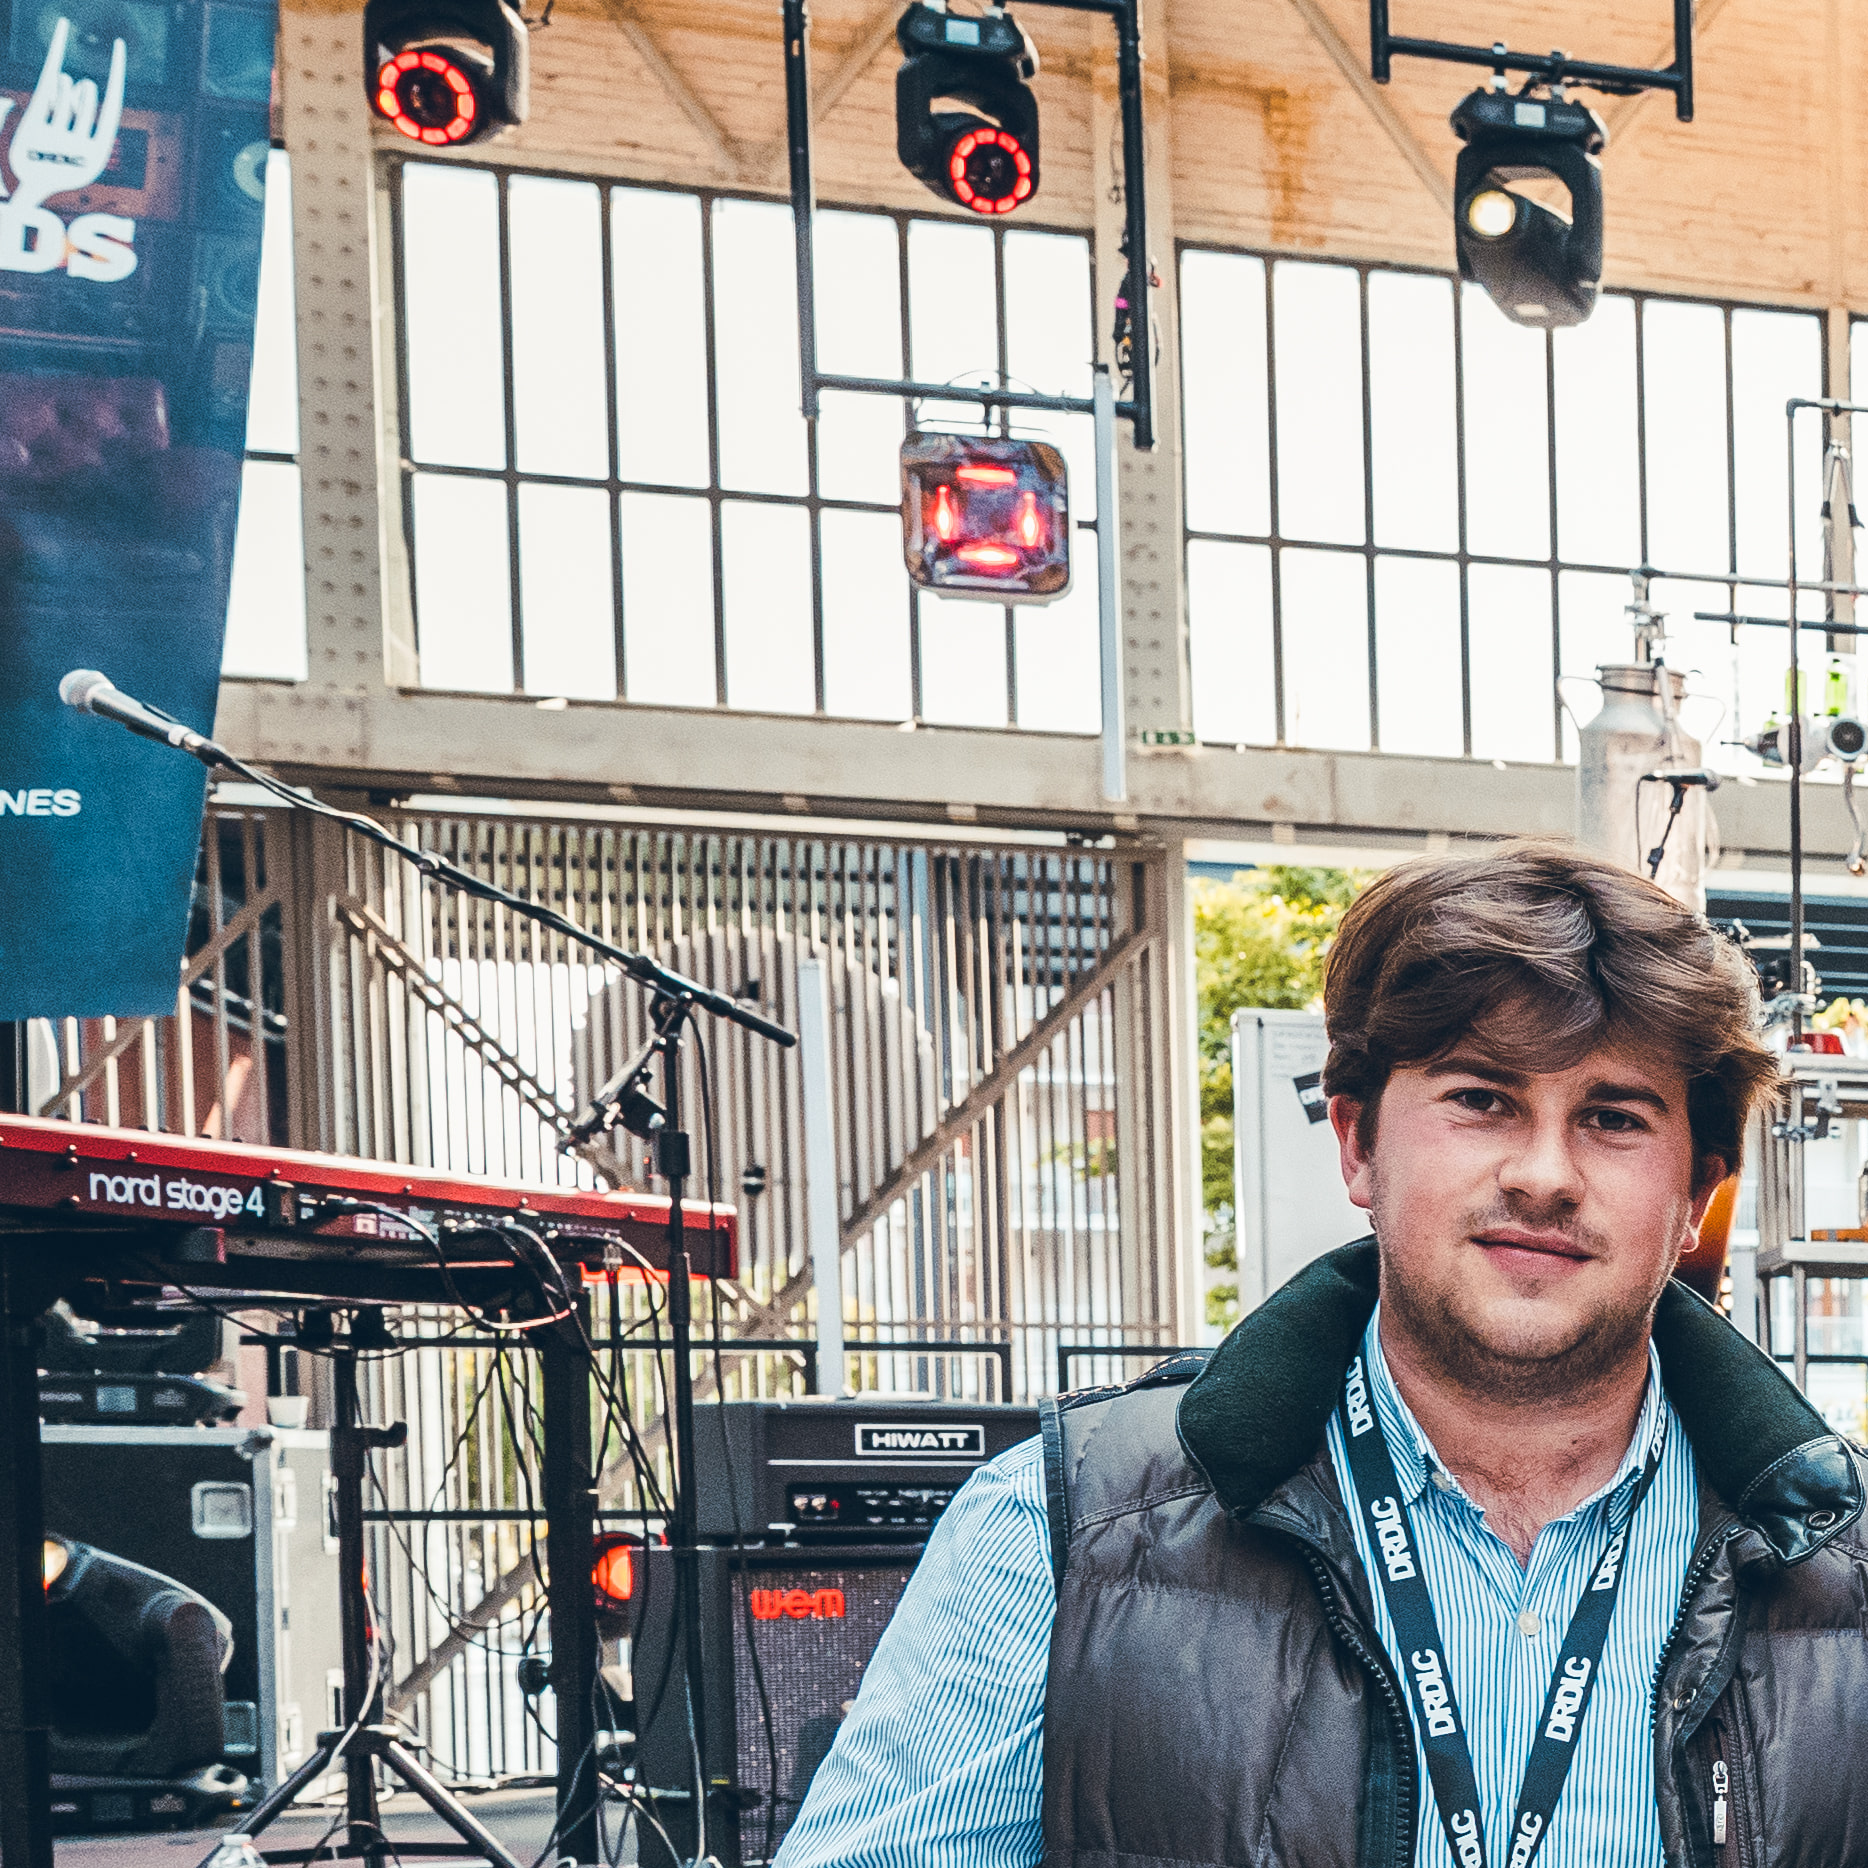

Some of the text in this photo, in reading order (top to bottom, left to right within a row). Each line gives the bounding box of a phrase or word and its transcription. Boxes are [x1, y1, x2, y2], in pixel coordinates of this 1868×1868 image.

[90, 1172, 265, 1220] nord stage 4
[1345, 1355, 1374, 1437] DRDLC
[872, 1432, 969, 1448] HIWATT
[1371, 1496, 1416, 1582] DRDLC
[1591, 1525, 1631, 1592] DRDL
[1411, 1648, 1457, 1737] DRDLC
[1544, 1655, 1592, 1743] DRDLC
